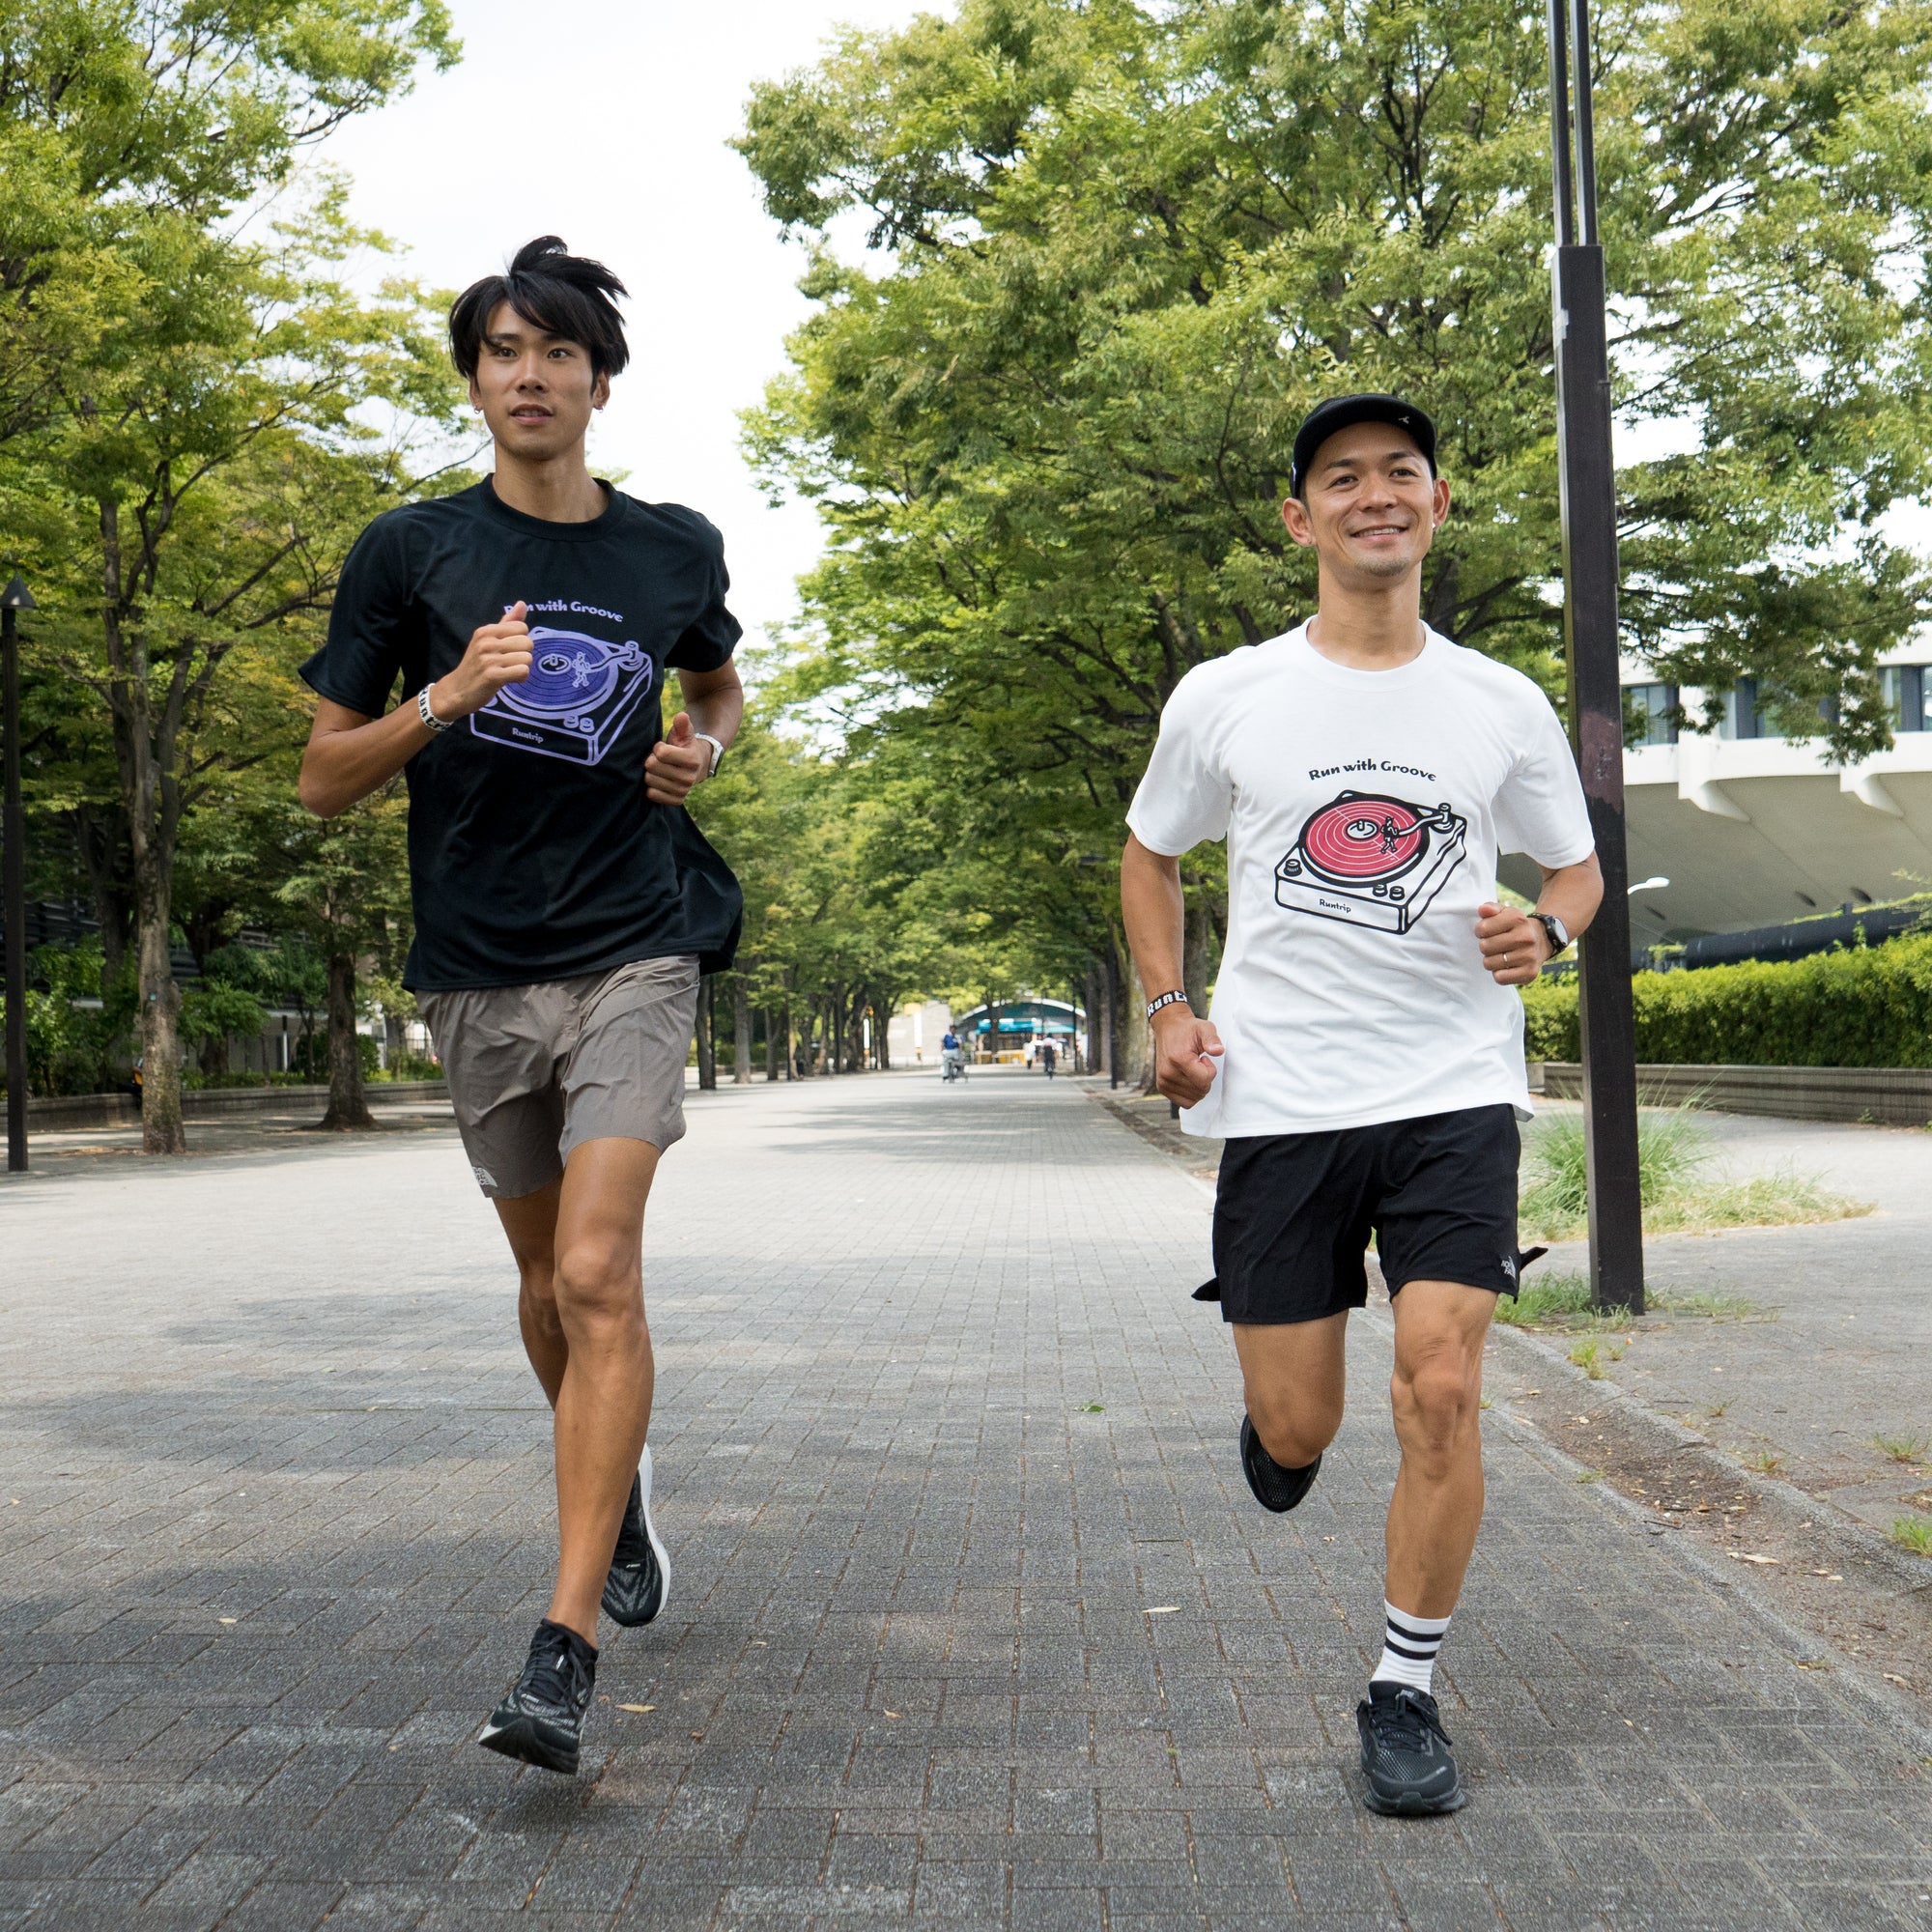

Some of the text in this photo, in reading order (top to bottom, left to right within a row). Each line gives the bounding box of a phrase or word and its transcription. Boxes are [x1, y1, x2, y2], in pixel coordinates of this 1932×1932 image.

[503, 599, 624, 623] Rn with Groove
[512, 726, 545, 744] Runtrip
[1308, 757, 1437, 781] Run with Groove
[1319, 898, 1351, 914] Runtrip
